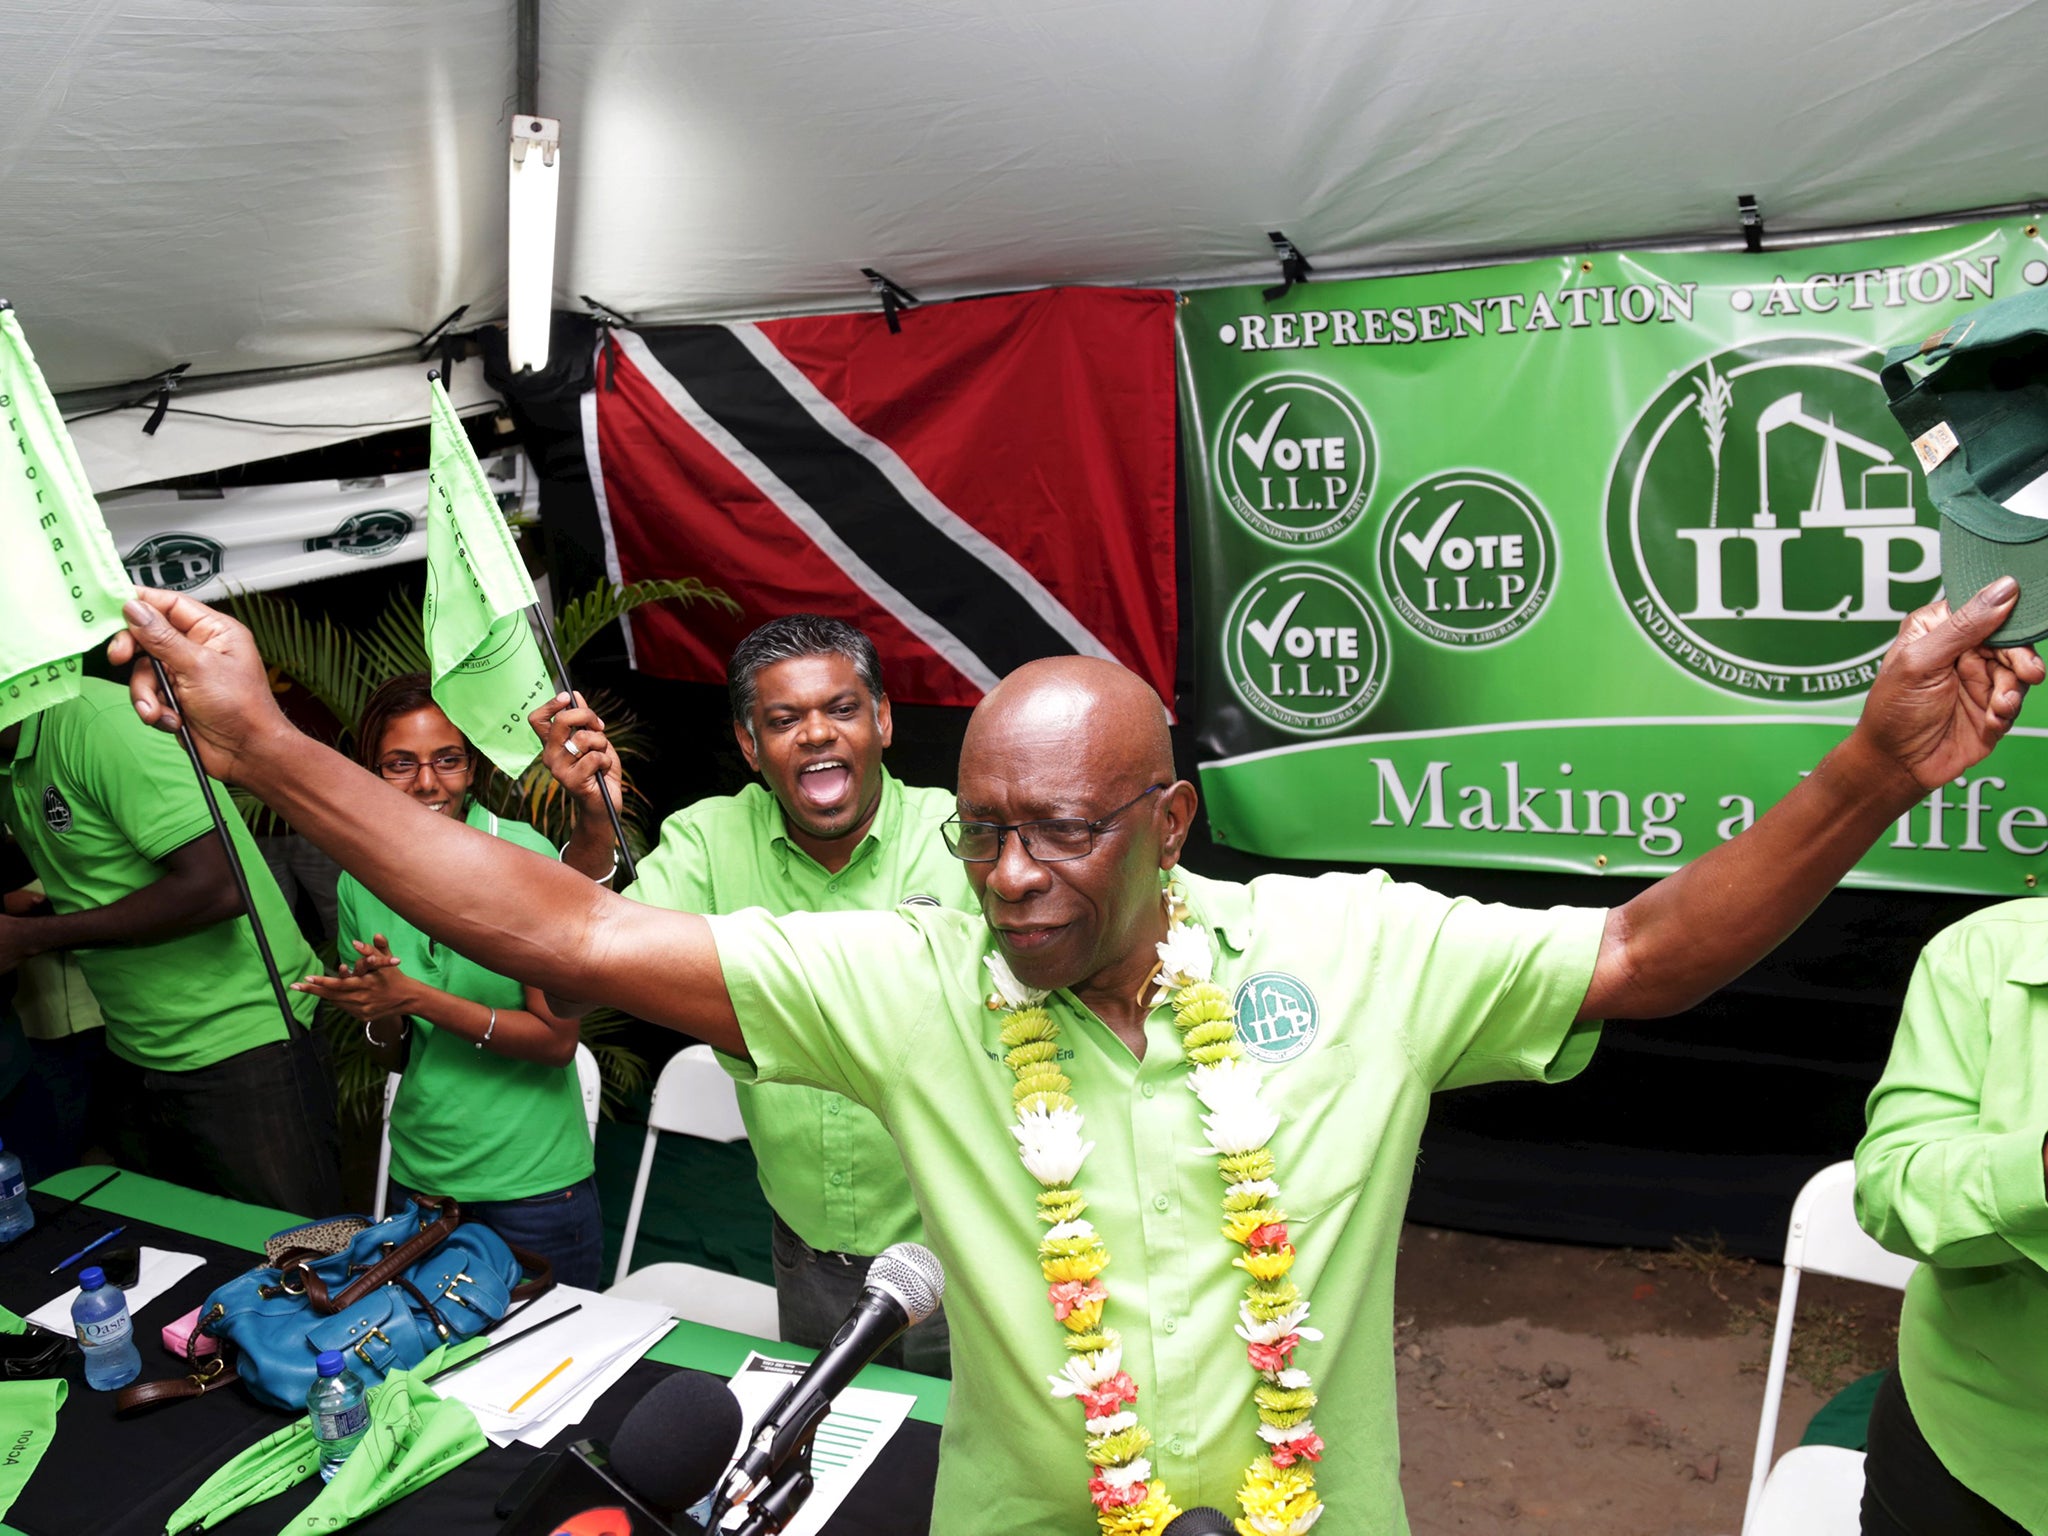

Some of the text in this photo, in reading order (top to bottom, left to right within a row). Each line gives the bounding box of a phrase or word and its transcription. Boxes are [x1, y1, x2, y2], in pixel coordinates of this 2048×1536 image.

[1239, 255, 1999, 351] REPRESENTATION ACTION
[1231, 489, 1368, 542] INDEPENDENT LIBERAL PARTY
[1392, 586, 1548, 644] INDEPENDENT LIBERAL PARTY
[1633, 594, 1790, 693] INDEPENDENT
[1240, 678, 1380, 728] INDEPENDENT LIBERAL PARTY
[1369, 757, 1687, 857] Making
[86, 1314, 126, 1337] Oasis
